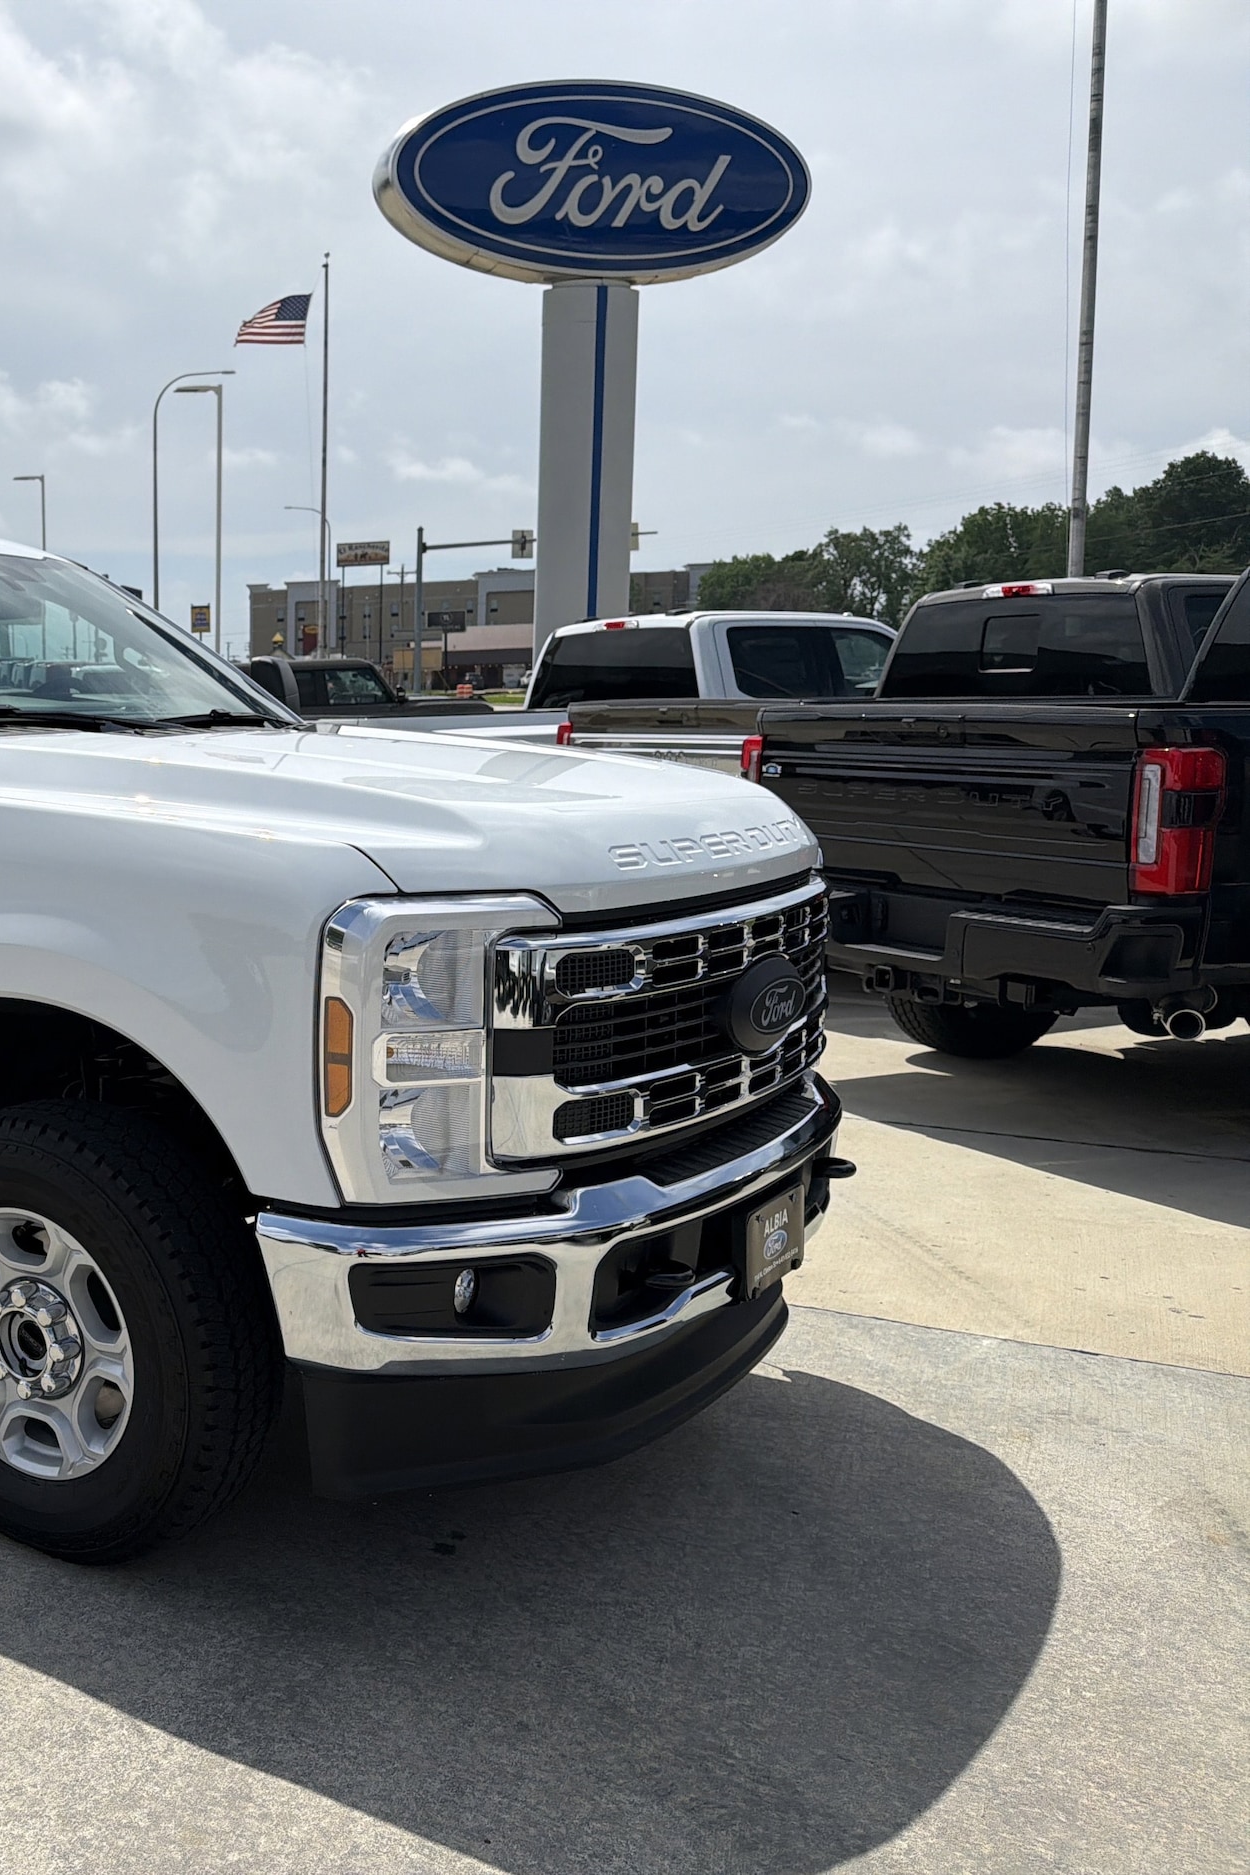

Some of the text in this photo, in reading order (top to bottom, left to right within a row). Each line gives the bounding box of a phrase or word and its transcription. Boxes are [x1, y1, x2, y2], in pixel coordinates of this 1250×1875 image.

[489, 116, 732, 232] Ford
[937, 791, 1063, 811] DUTY
[608, 831, 753, 870] SUPER
[761, 984, 797, 1027] Ford
[764, 1208, 788, 1237] ALBIA
